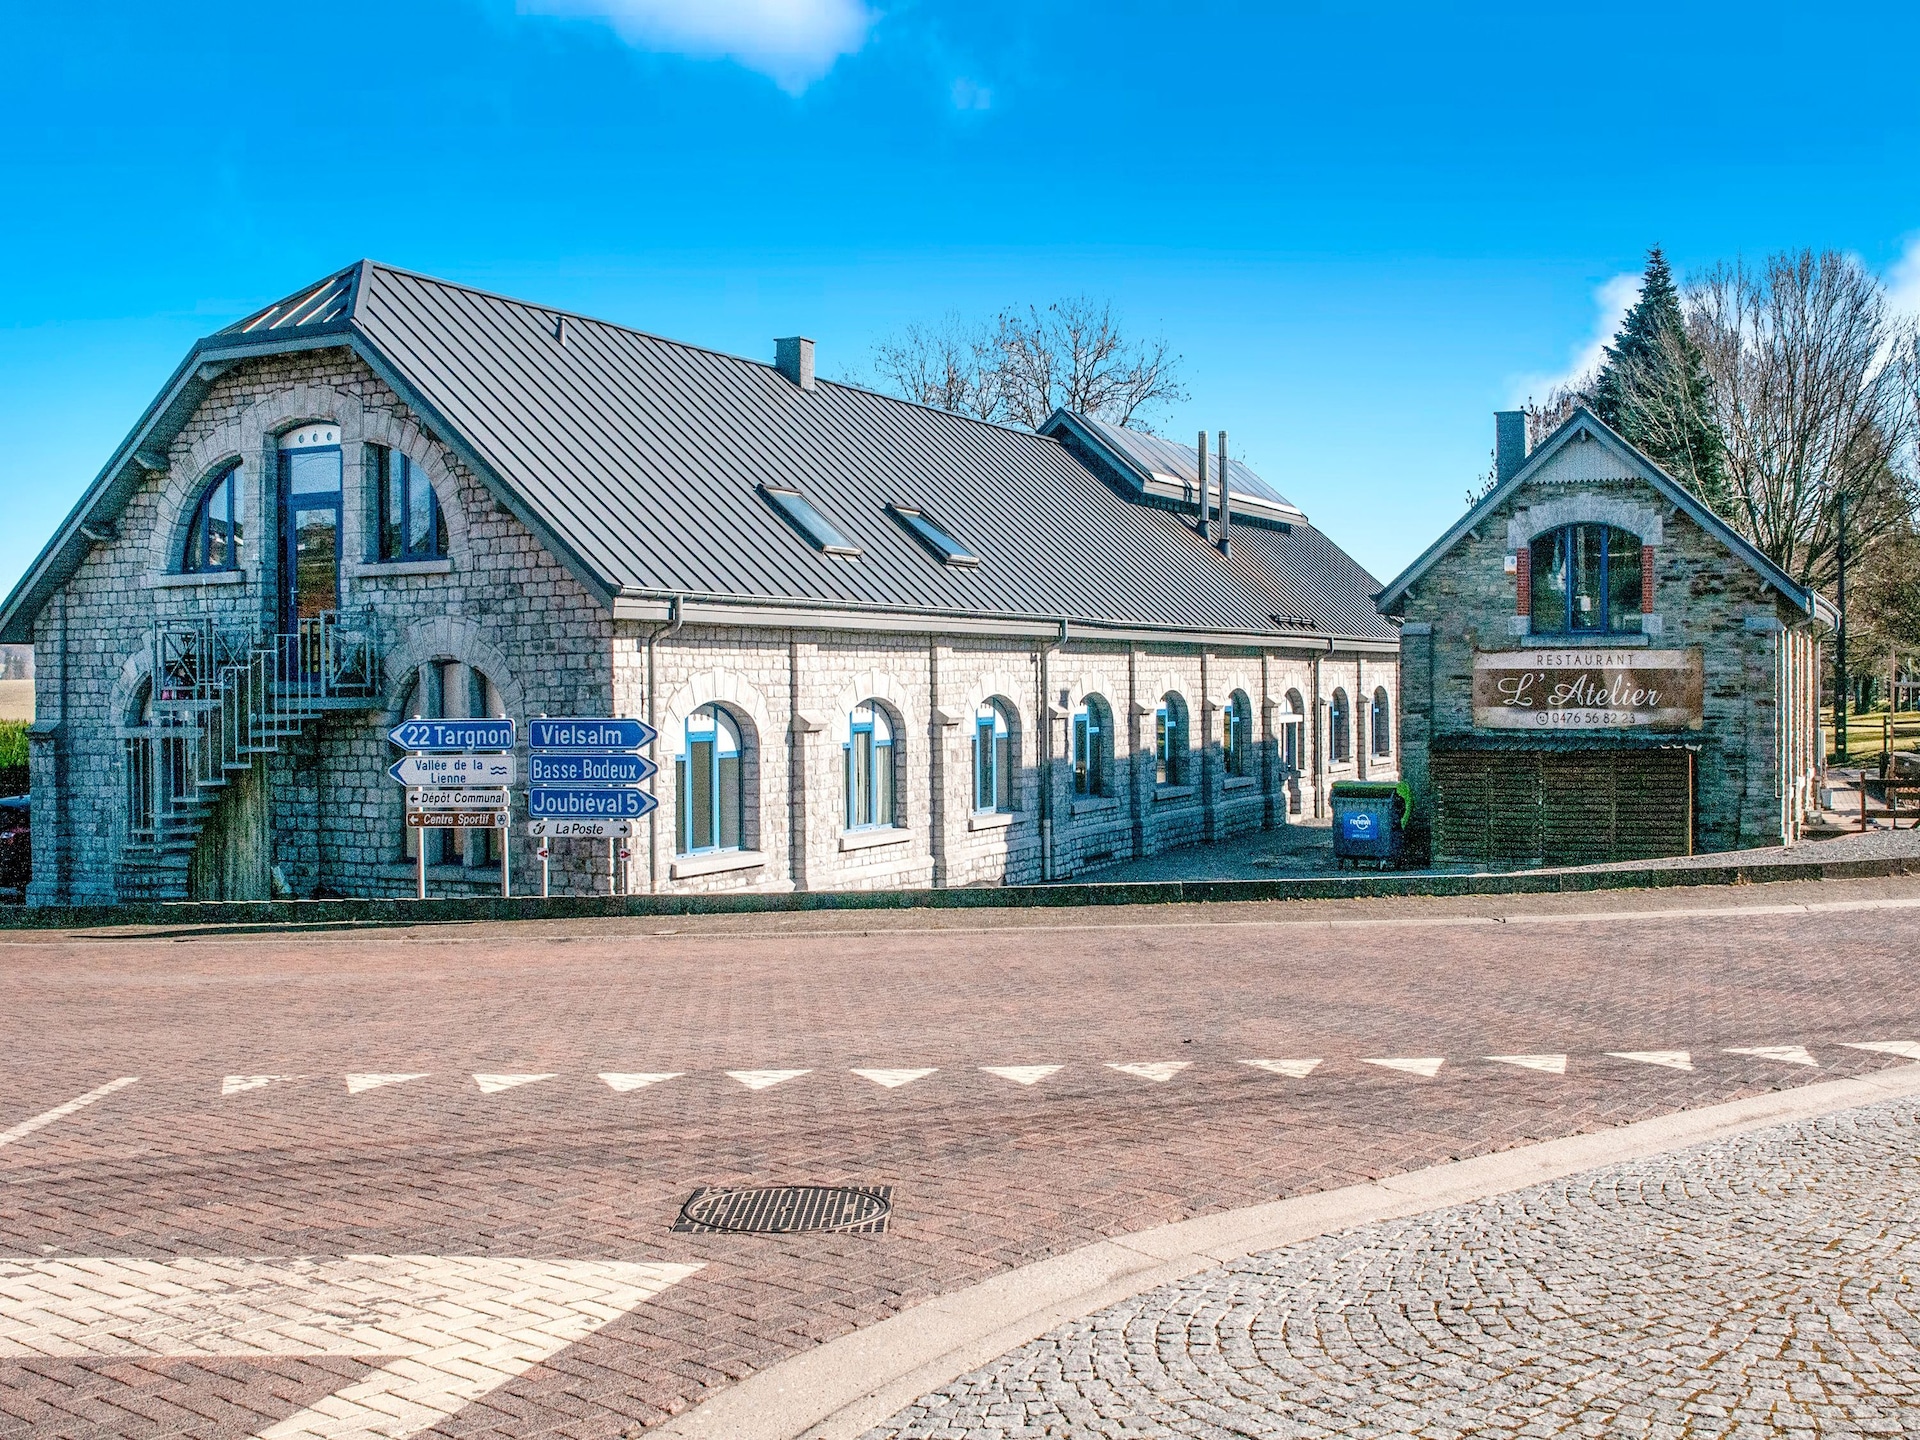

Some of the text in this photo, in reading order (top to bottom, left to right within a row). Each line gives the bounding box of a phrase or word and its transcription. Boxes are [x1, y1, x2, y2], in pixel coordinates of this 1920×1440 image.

[1536, 654, 1635, 666] RESTAURANT
[1552, 712, 1636, 724] 0476 56 82 23
[407, 725, 510, 750] 22 Targnon
[540, 724, 622, 745] Vielsalm
[415, 759, 483, 771] Vallée de la
[533, 759, 637, 779] Basse-Bodeux
[431, 773, 466, 784] Lienne
[421, 792, 505, 805] Dépôt Communal
[533, 792, 639, 814] Joubiéval 5
[423, 814, 490, 827] Centre Sportif
[555, 823, 604, 835] La Poste
